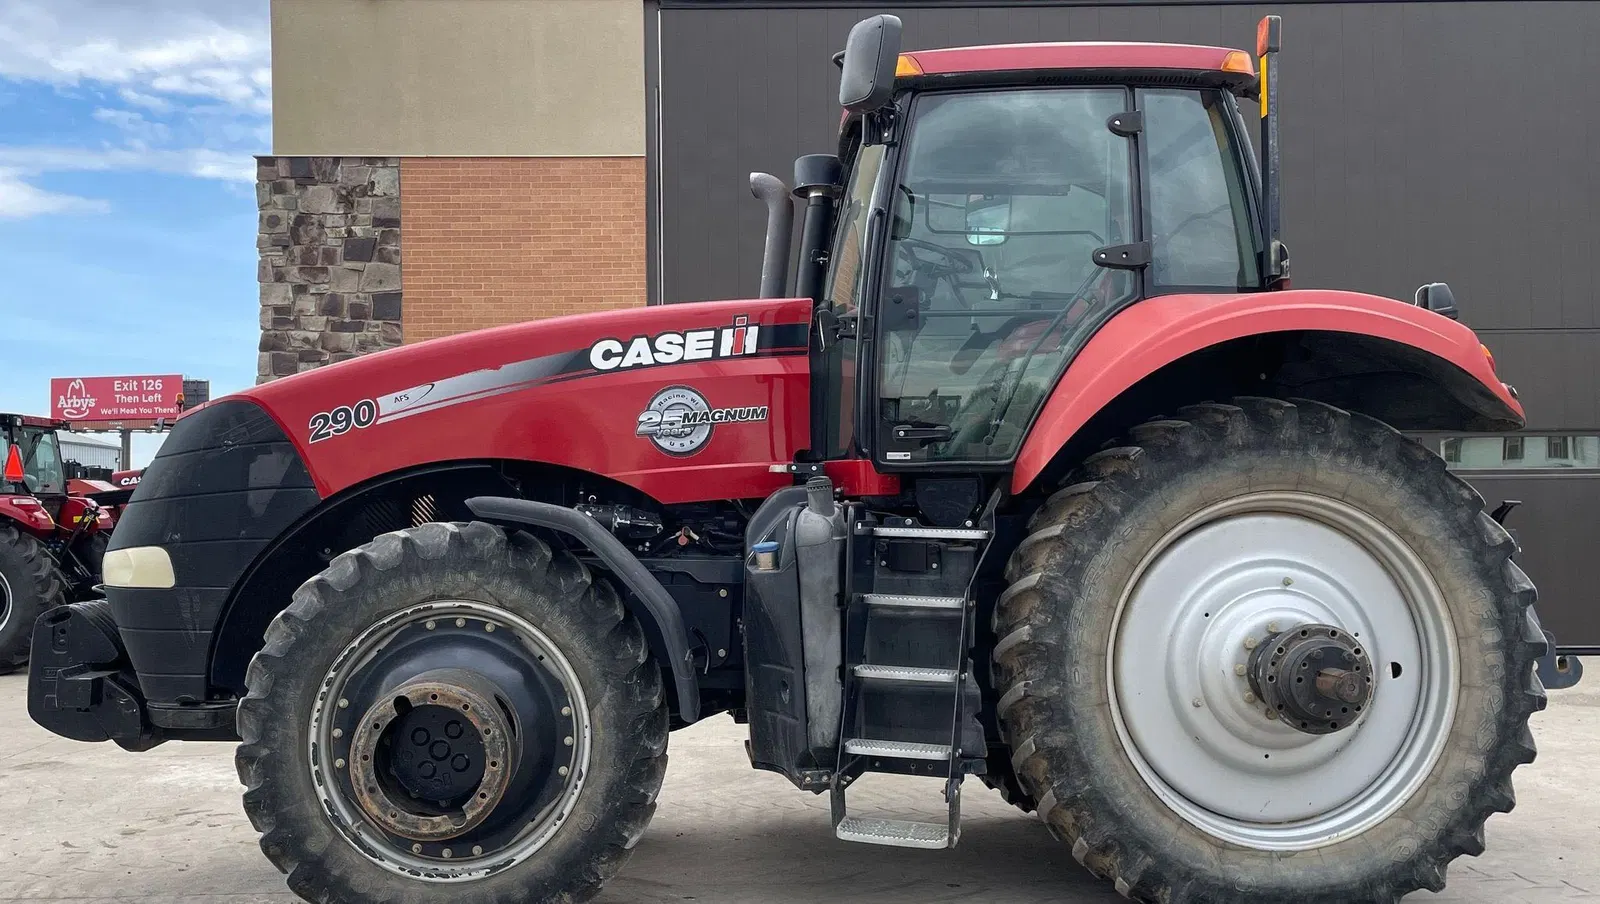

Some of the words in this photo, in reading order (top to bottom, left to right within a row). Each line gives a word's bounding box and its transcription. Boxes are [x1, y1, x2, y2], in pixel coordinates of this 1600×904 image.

[590, 333, 715, 370] CASE
[114, 380, 138, 391] Exit
[142, 379, 163, 391] 126
[57, 395, 95, 410] Arby's
[115, 394, 139, 403] Then
[142, 393, 162, 402] Left
[394, 393, 409, 403] AFS
[101, 407, 118, 415] We'll
[139, 406, 153, 414] You
[154, 406, 177, 414] There!
[681, 407, 768, 424] MAGNUM
[309, 399, 376, 444] 290
[636, 409, 686, 435] 25
[656, 426, 692, 439] years
